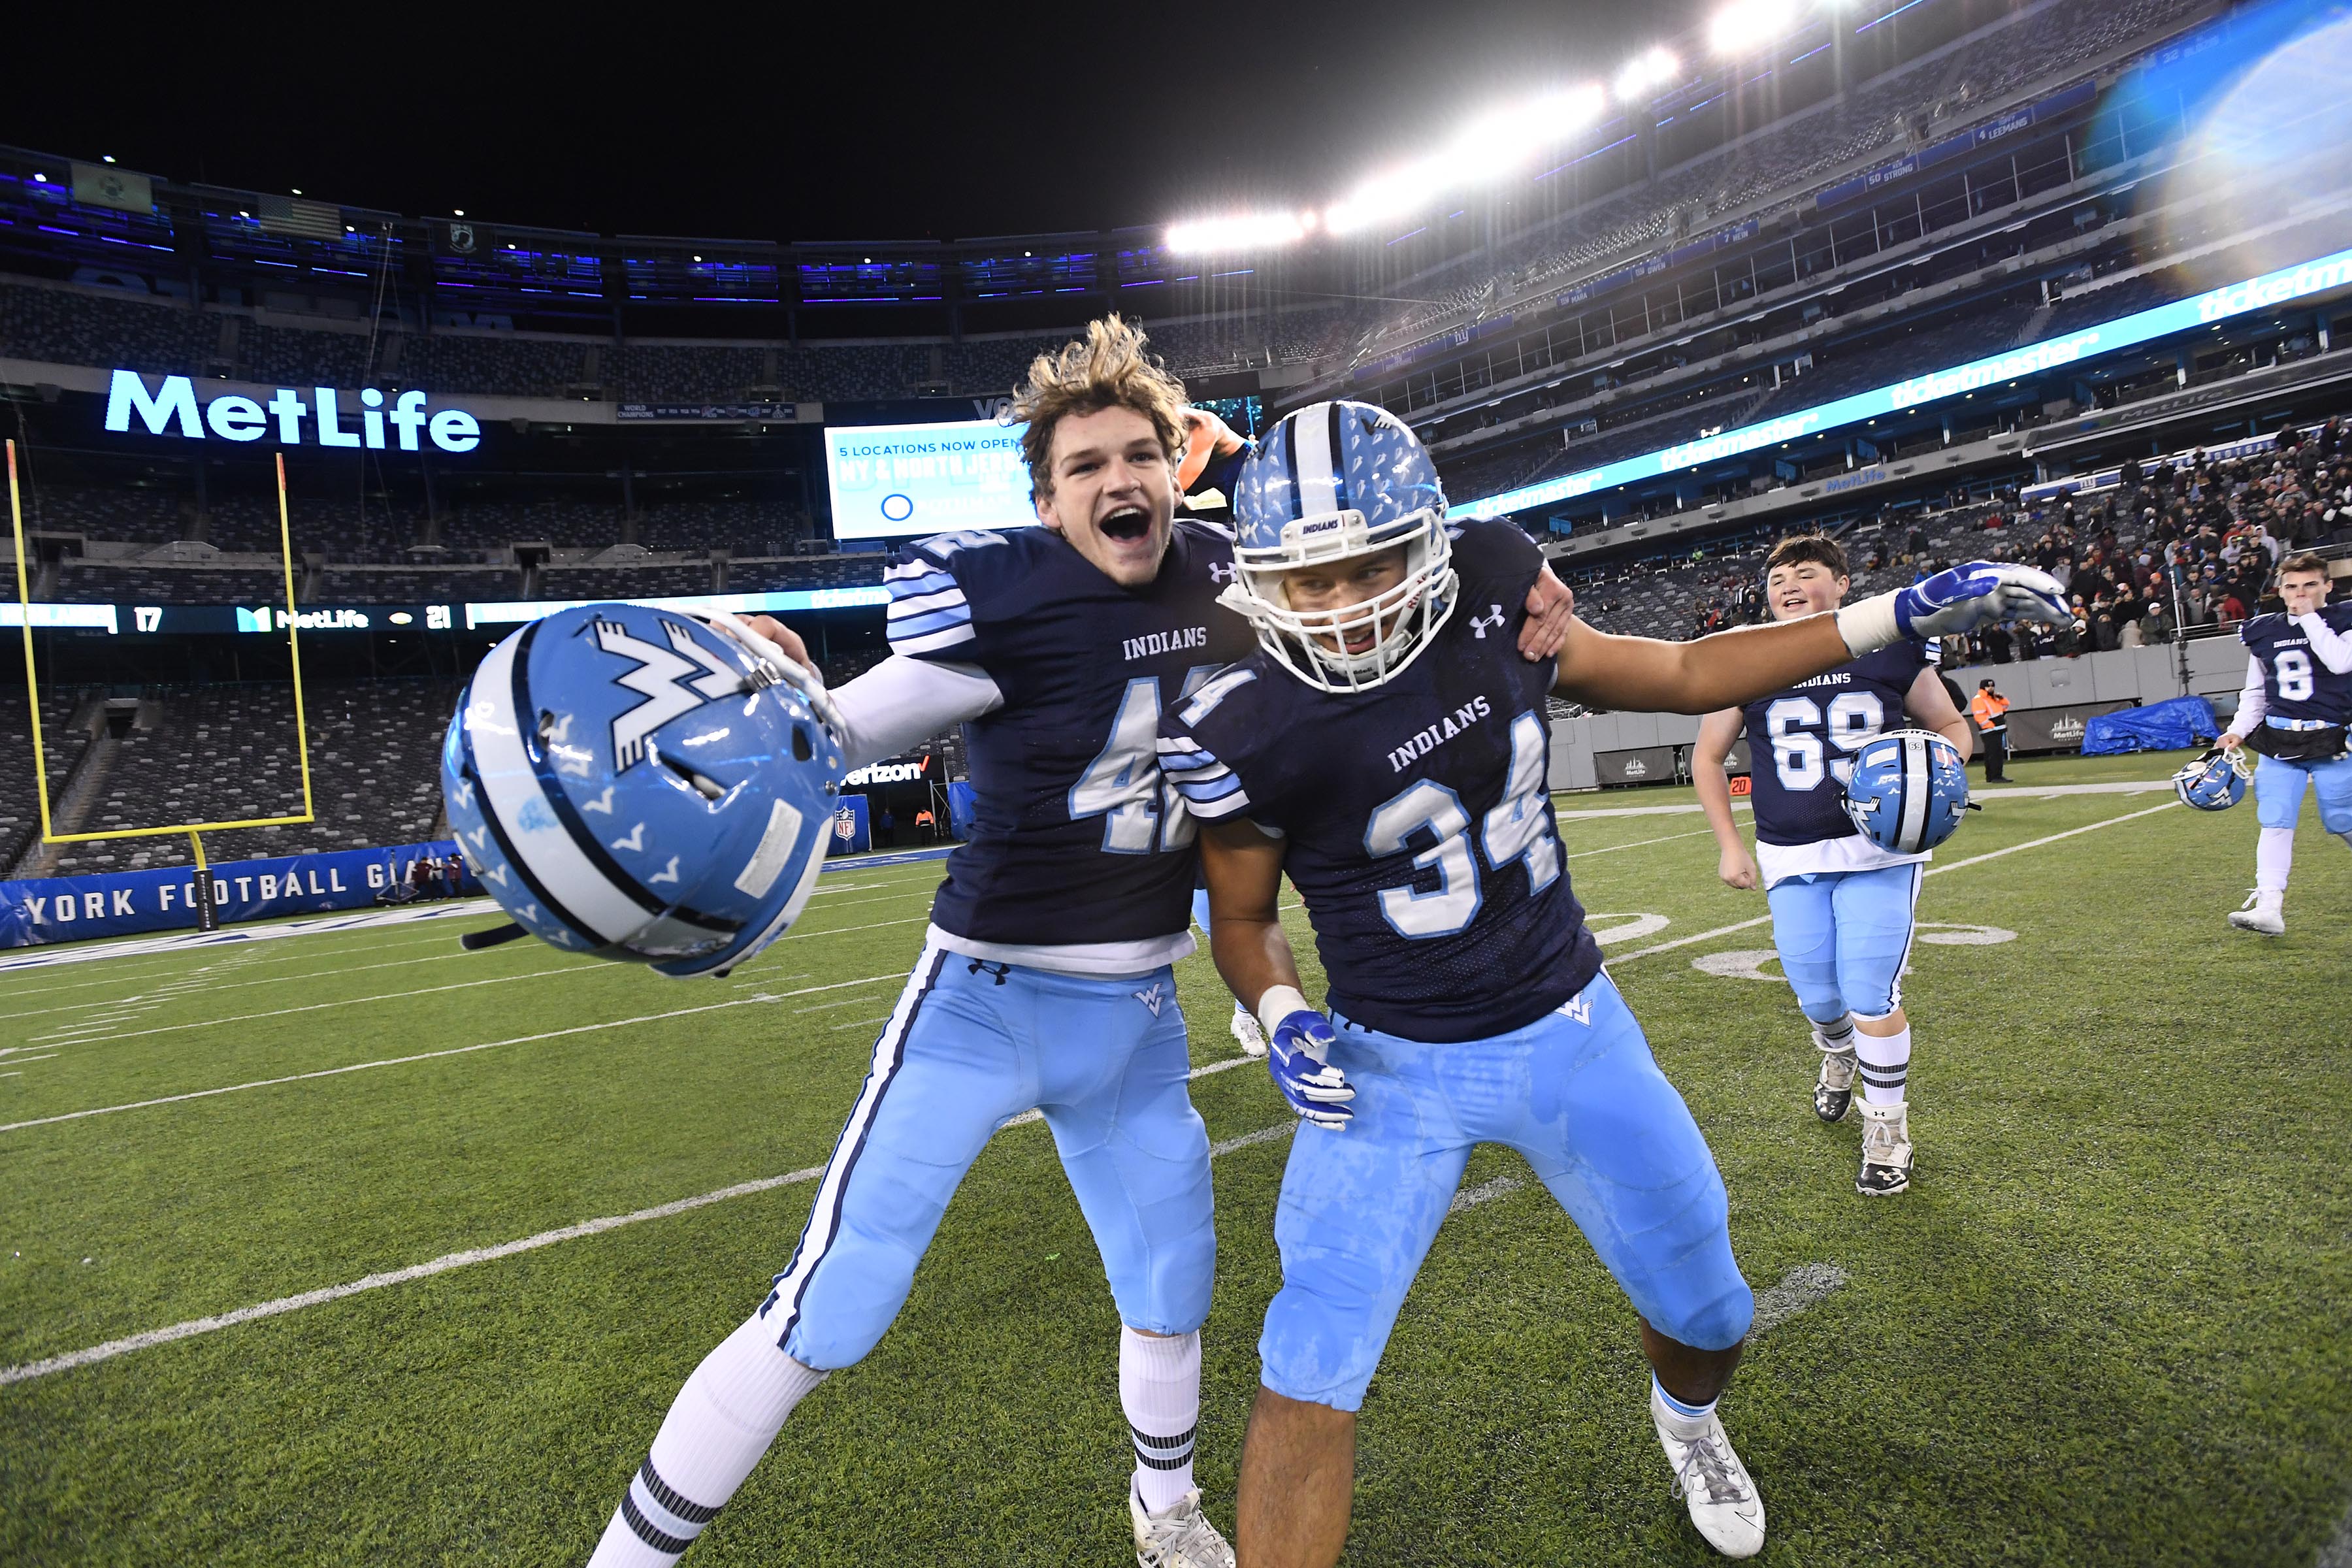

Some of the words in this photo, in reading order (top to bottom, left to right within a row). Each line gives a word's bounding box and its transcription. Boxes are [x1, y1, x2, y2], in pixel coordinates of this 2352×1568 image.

[1979, 129, 1986, 140] 4
[1989, 116, 2028, 140] LEEMANS
[1869, 173, 1881, 186] 50
[1884, 163, 1914, 183] STRONG
[1890, 340, 2085, 410] ticketmaster
[104, 369, 481, 453] MetLife
[840, 447, 848, 457] 5
[853, 441, 936, 456] LOCATIONS
[941, 440, 976, 451] NOW
[1659, 418, 1807, 472] ticketmaster
[840, 459, 870, 482] NY
[875, 458, 890, 480] &
[893, 455, 963, 479] NORTH
[1825, 468, 1886, 493] MetLife
[1475, 474, 1595, 518] ticketmaster
[1302, 519, 1339, 535] INDIANS
[133, 606, 163, 632] 17
[276, 609, 370, 629] MetLife
[426, 605, 451, 629] 21
[1122, 627, 1207, 661] INDIANS
[2039, 636, 2055, 645] USA
[2273, 638, 2310, 649] INDIANS
[1793, 672, 1852, 689] DIANS
[2273, 649, 2315, 702] 8
[1386, 694, 1492, 774] INDIANS
[1765, 691, 1885, 791] 69
[1908, 742, 1923, 751] 69
[1731, 779, 1746, 793] 20
[838, 821, 853, 836] NFL
[1362, 708, 1561, 941] 34
[23, 889, 136, 926] YORK
[158, 868, 348, 911] FOOTBALL
